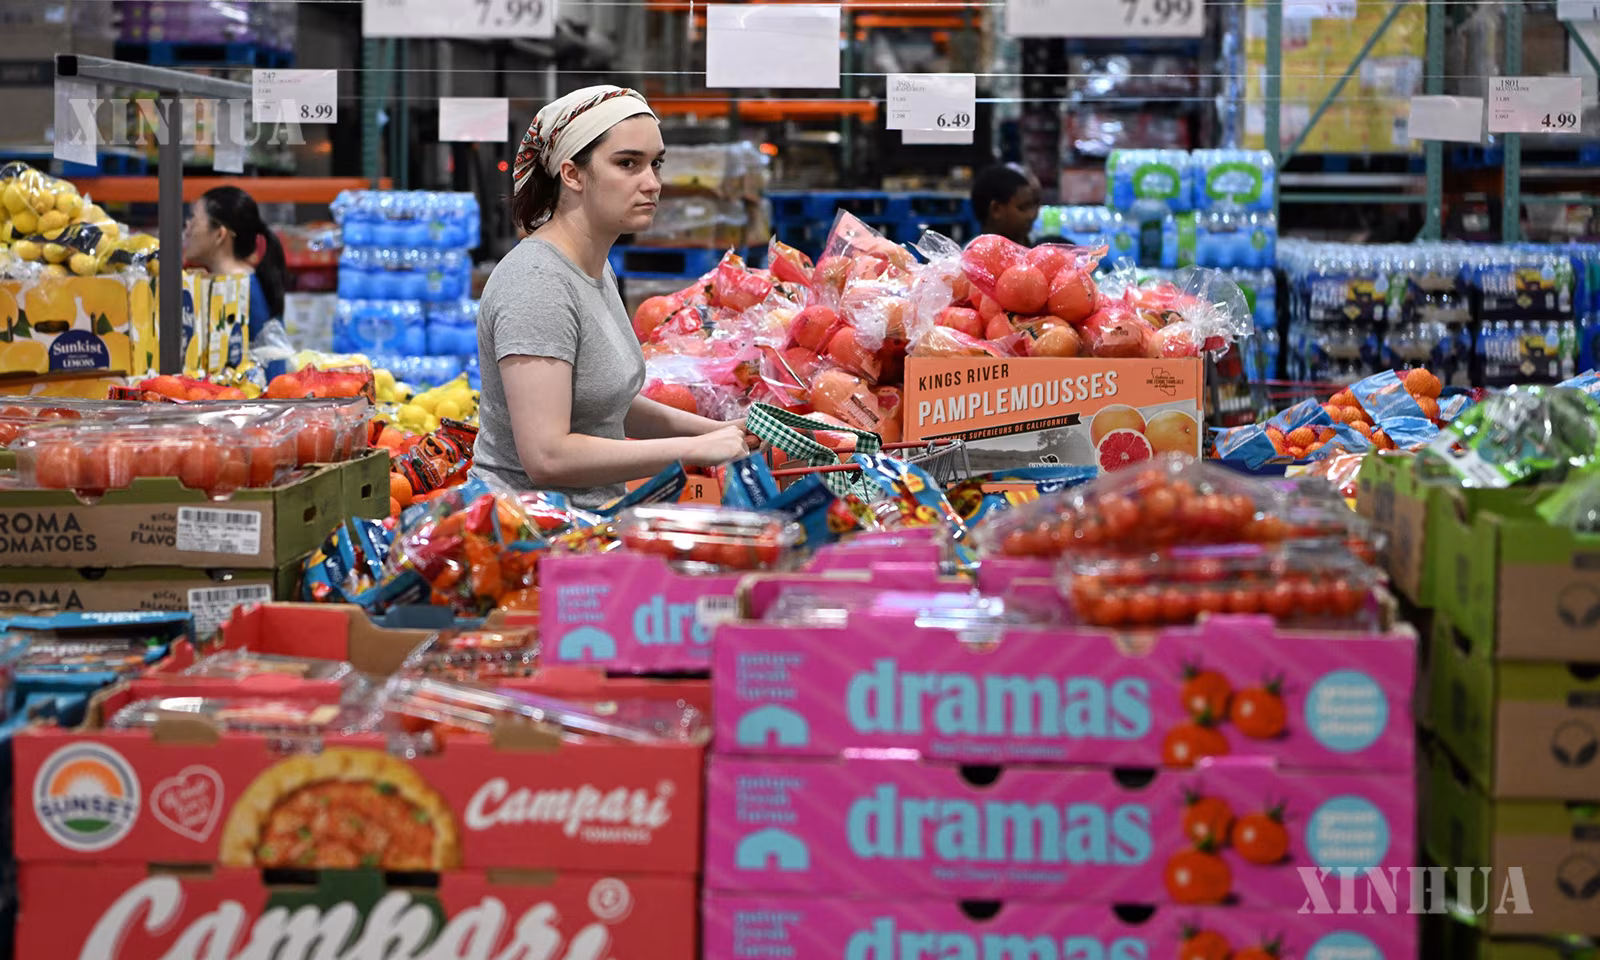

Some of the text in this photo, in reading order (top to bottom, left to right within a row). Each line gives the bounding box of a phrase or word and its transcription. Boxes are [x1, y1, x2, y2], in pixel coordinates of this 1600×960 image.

[474, 0, 543, 27] 7.99
[1118, 0, 1193, 26] 7.99
[1501, 79, 1519, 88] 1801
[300, 104, 333, 118] 8.99
[937, 113, 970, 127] 6.49
[1541, 113, 1577, 128] 4.99
[53, 340, 103, 356] Sunkist
[62, 358, 96, 368] LEMONS
[919, 363, 1009, 391] KINGS RIVER
[918, 370, 1119, 427] PAMPLEMOUSSES
[969, 426, 1013, 440] SUPÉRIEURS
[1014, 424, 1024, 432] DE
[1026, 416, 1068, 431] CALIFORNIE
[0, 512, 82, 534] ROMA
[130, 531, 176, 547] FLAVO
[846, 659, 1152, 741] dramas
[41, 795, 136, 817] SUNSET
[464, 777, 672, 837] Campari
[846, 784, 1154, 865] dramas
